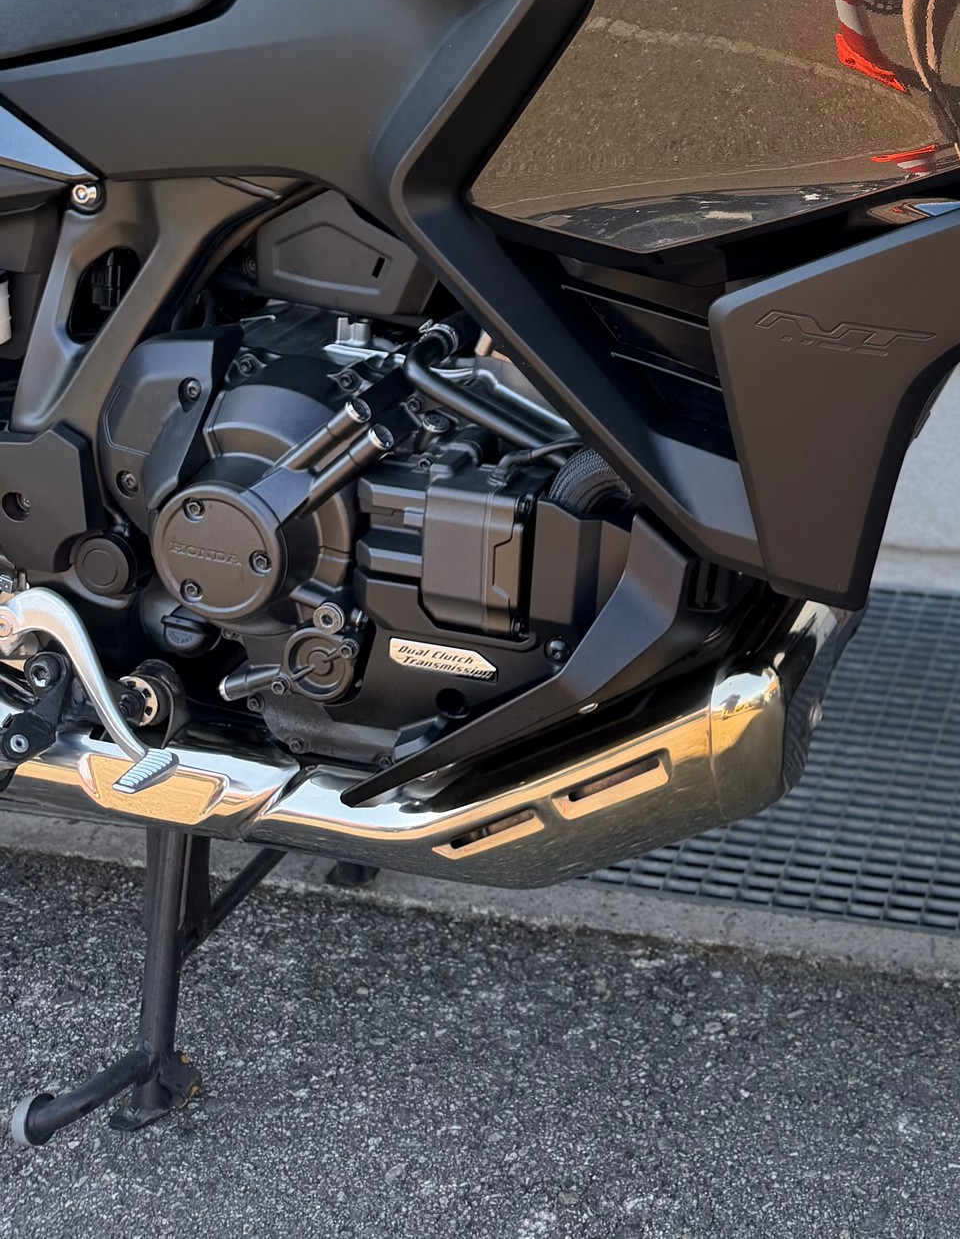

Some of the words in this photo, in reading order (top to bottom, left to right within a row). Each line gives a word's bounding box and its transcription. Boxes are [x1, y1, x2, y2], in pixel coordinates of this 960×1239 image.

[168, 541, 244, 567] HONDA
[397, 645, 431, 657] Dual
[431, 650, 475, 665] Clutch
[403, 656, 494, 680] Transmission
